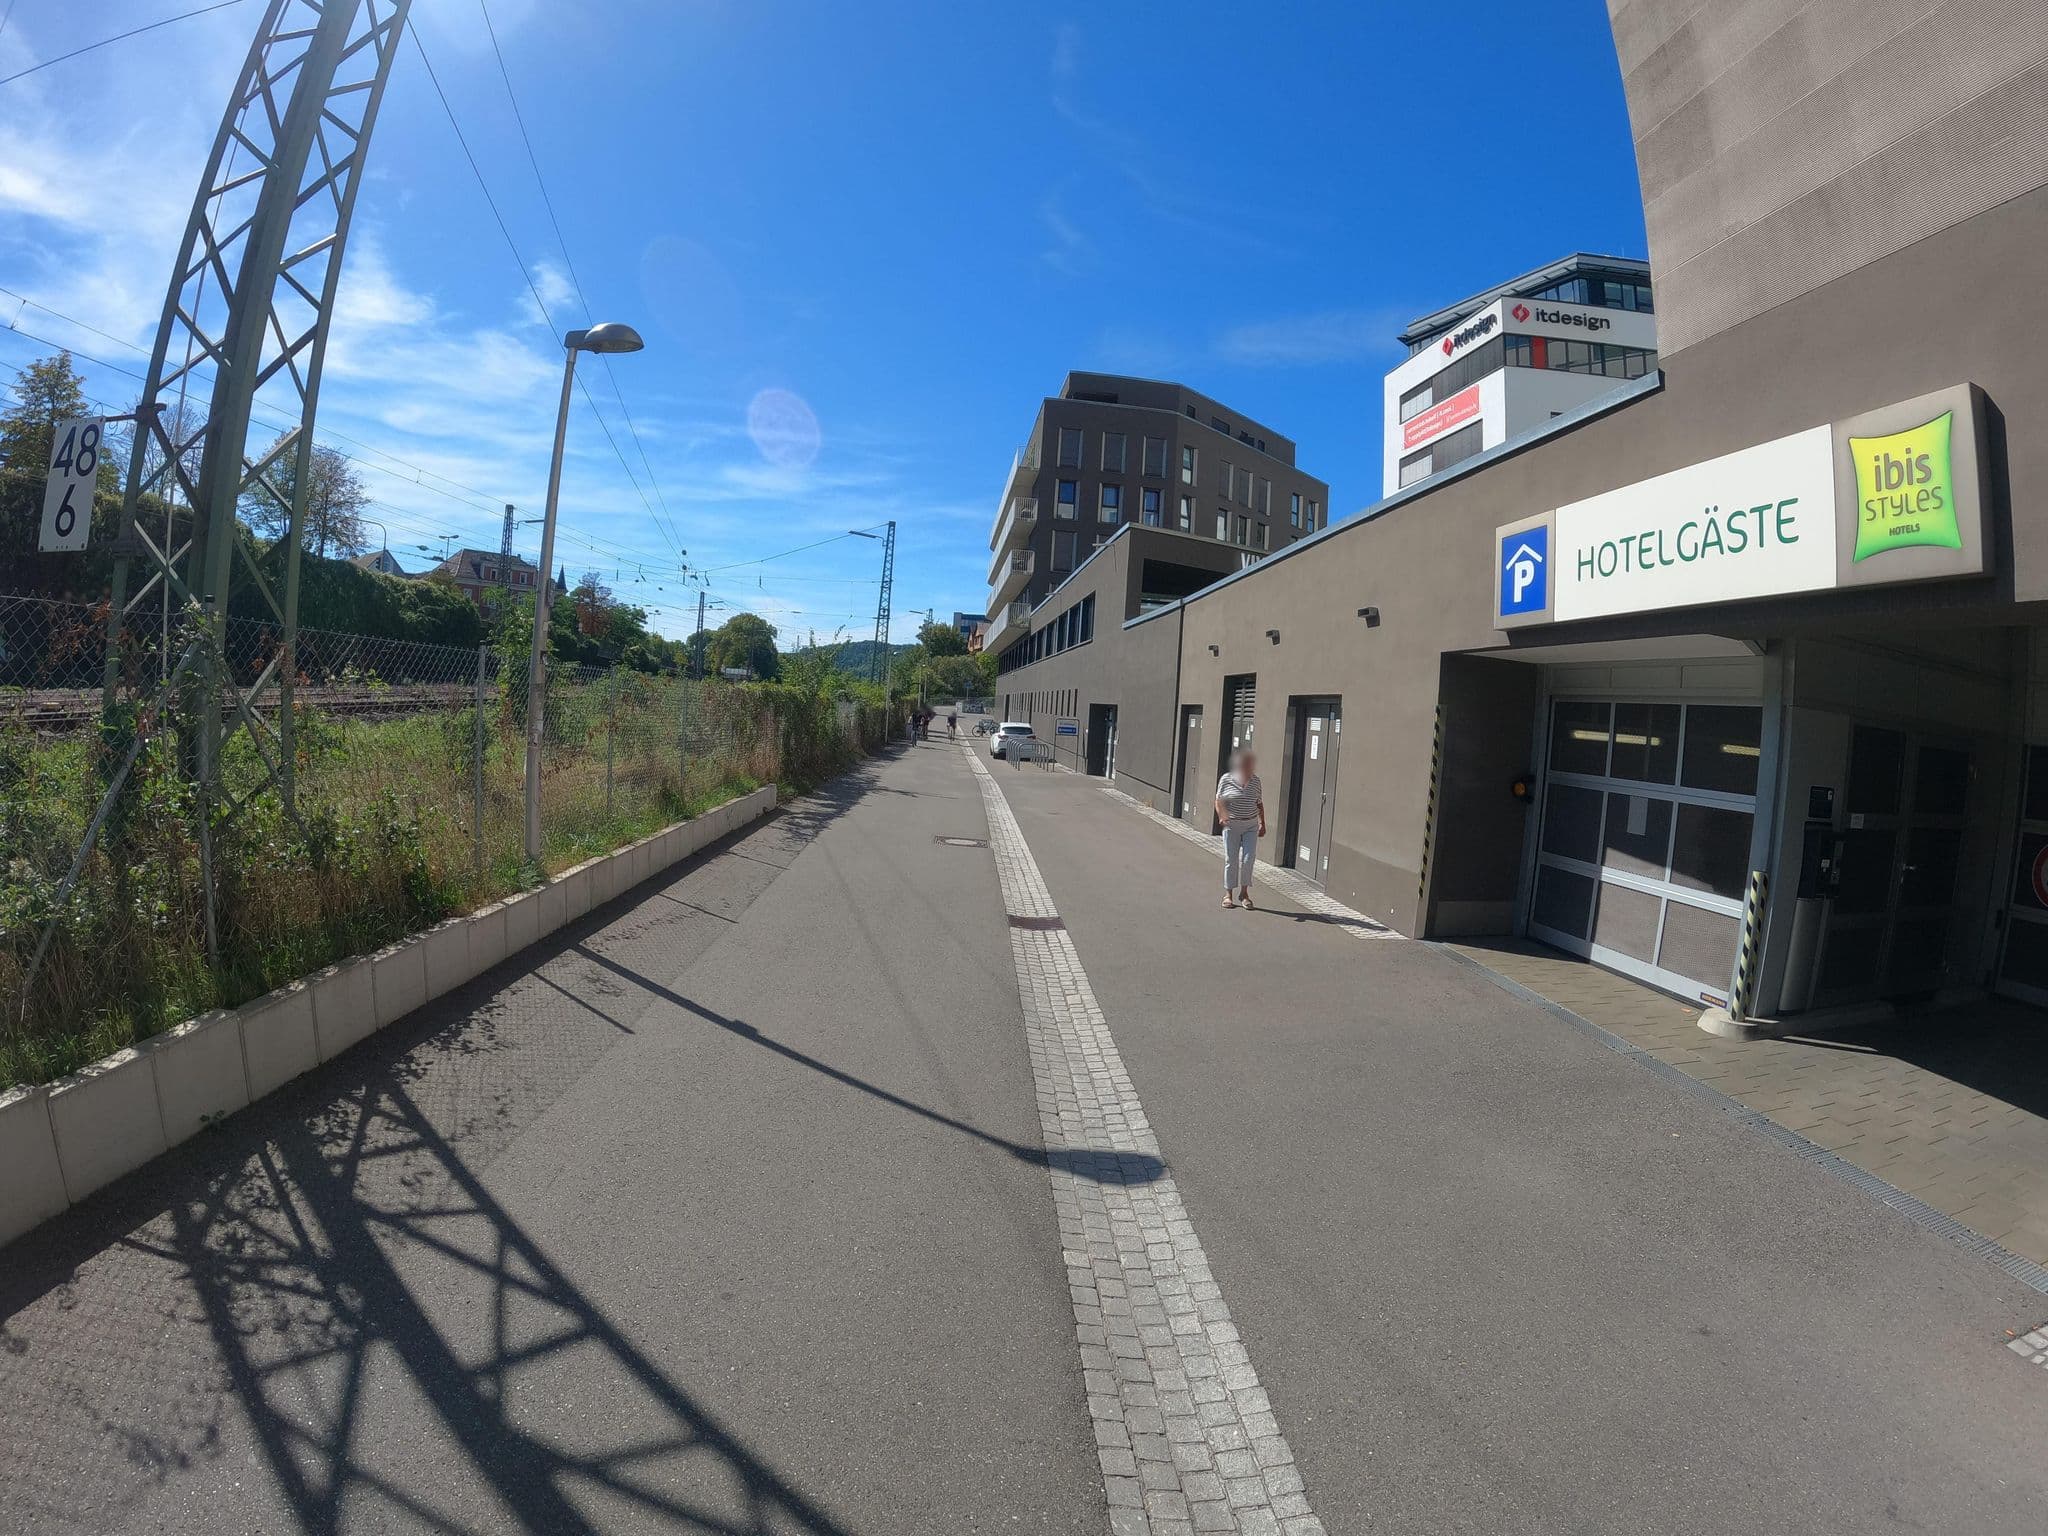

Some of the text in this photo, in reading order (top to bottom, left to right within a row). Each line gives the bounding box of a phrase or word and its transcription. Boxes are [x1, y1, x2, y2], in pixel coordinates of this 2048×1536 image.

[1453, 313, 1498, 350] itdesign
[1535, 307, 1611, 332] itdesign
[52, 423, 100, 478] 48
[1874, 448, 1932, 492] ibis
[55, 484, 76, 538] 6
[1889, 523, 1920, 536] HOTELS
[1577, 497, 1800, 582] HOTELGÄSTE
[1513, 560, 1535, 603] P
